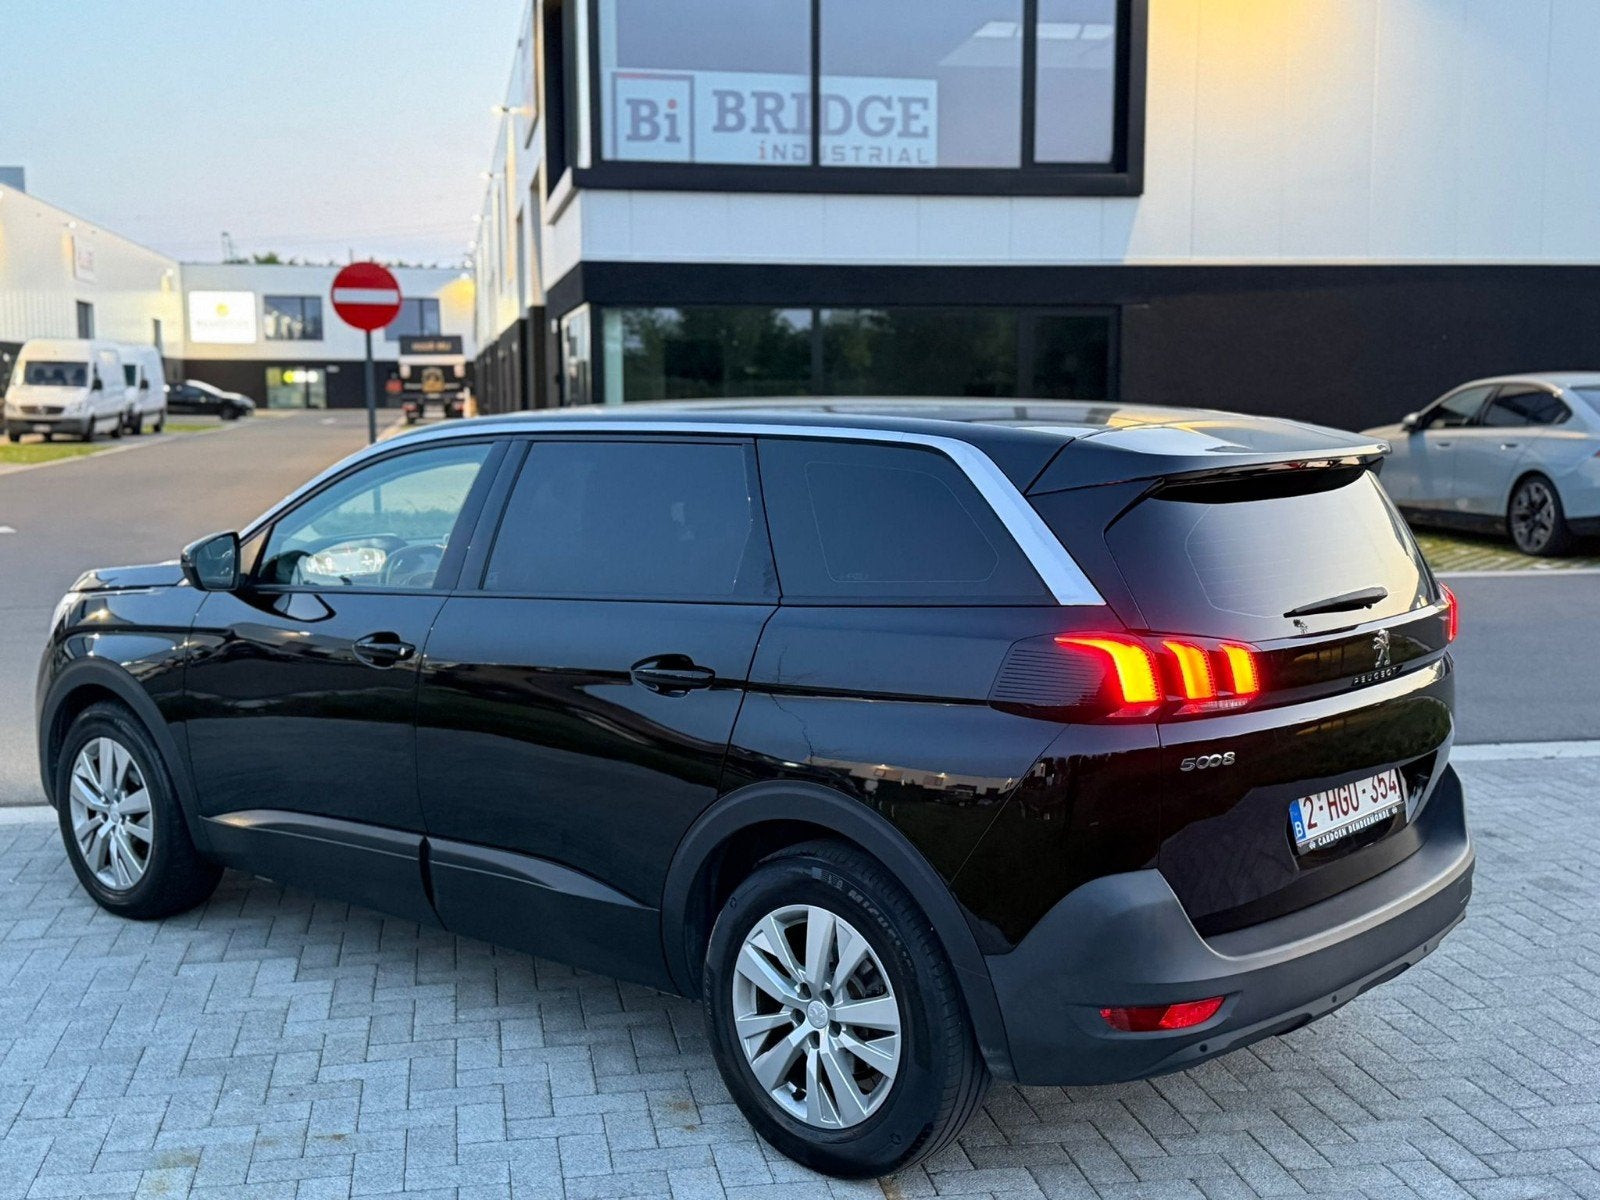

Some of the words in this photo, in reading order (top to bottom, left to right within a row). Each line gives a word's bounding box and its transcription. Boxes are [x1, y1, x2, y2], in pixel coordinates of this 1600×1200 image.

[625, 98, 681, 143] Bi
[711, 89, 931, 139] BRIDGE
[1353, 666, 1398, 686] PEUGEOT
[1179, 751, 1236, 772] 5008
[1293, 821, 1304, 838] B
[1317, 828, 1347, 846] CARDOEN
